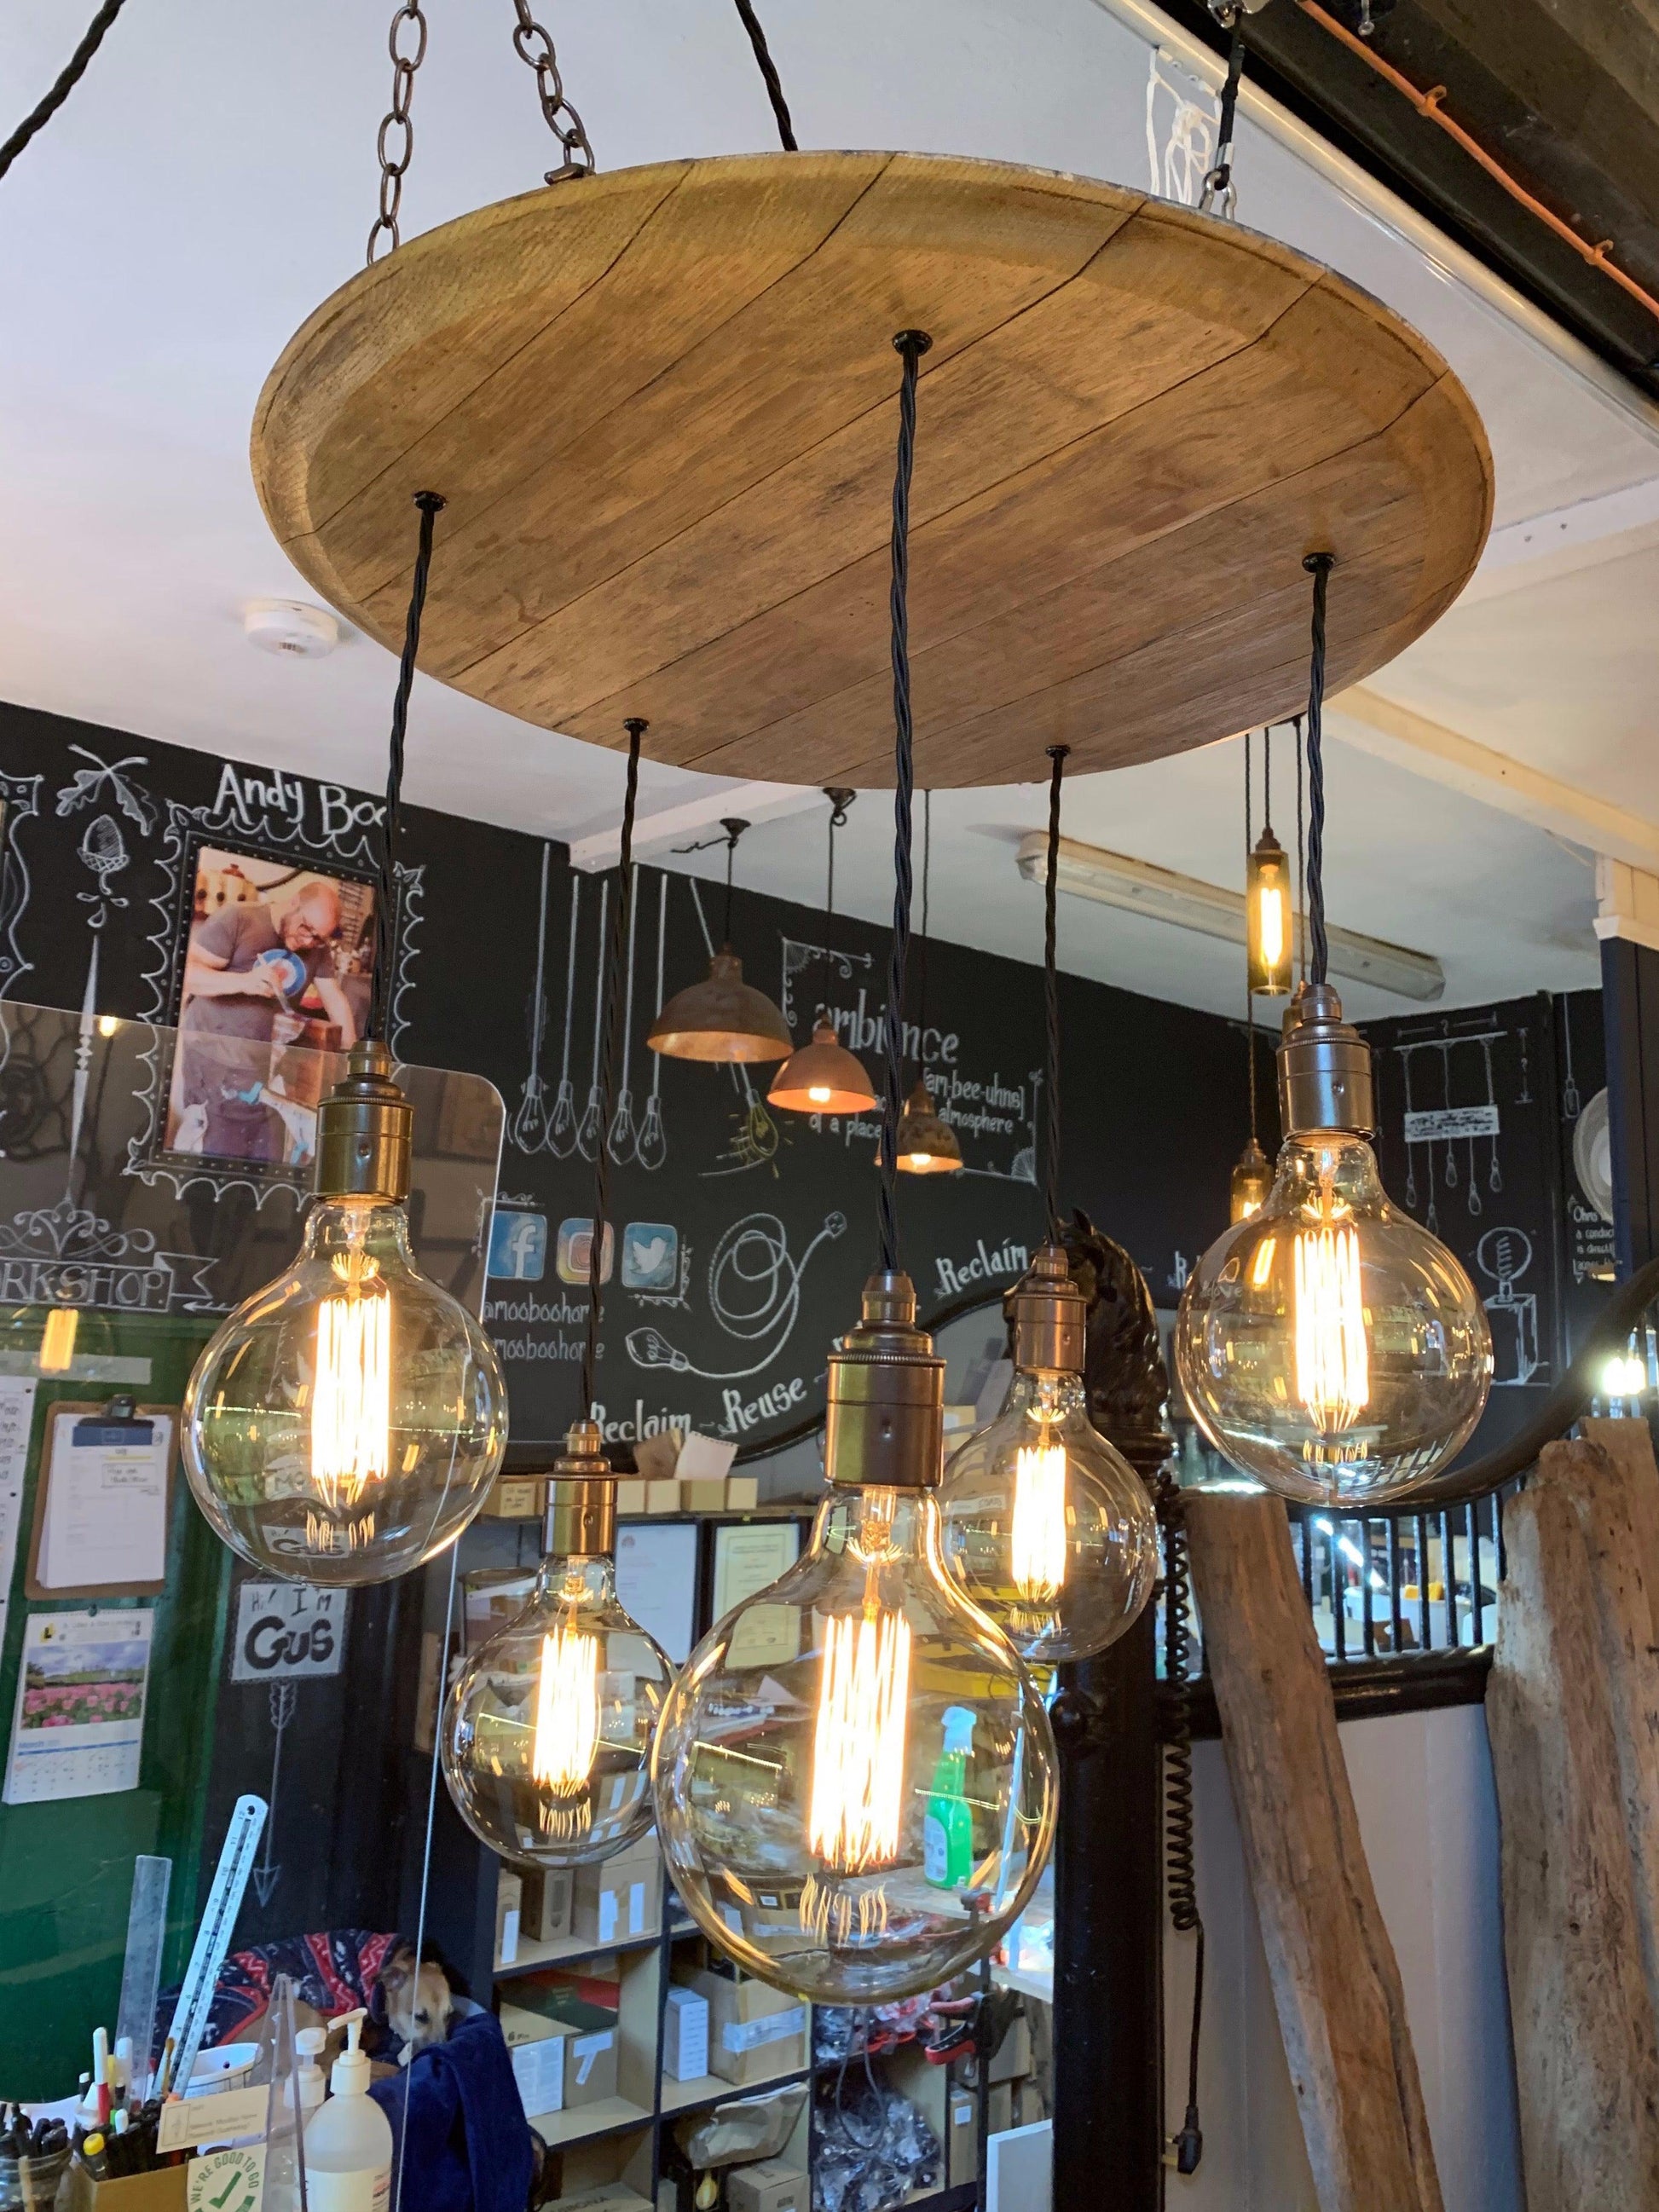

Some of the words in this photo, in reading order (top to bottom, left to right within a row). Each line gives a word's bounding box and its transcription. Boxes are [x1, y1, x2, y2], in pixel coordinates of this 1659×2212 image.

[213, 764, 304, 825] Andy
[813, 988, 959, 1064] ambince
[830, 1117, 840, 1134] a
[720, 1376, 808, 1436] Reuse
[213, 2151, 245, 2169] GOOD
